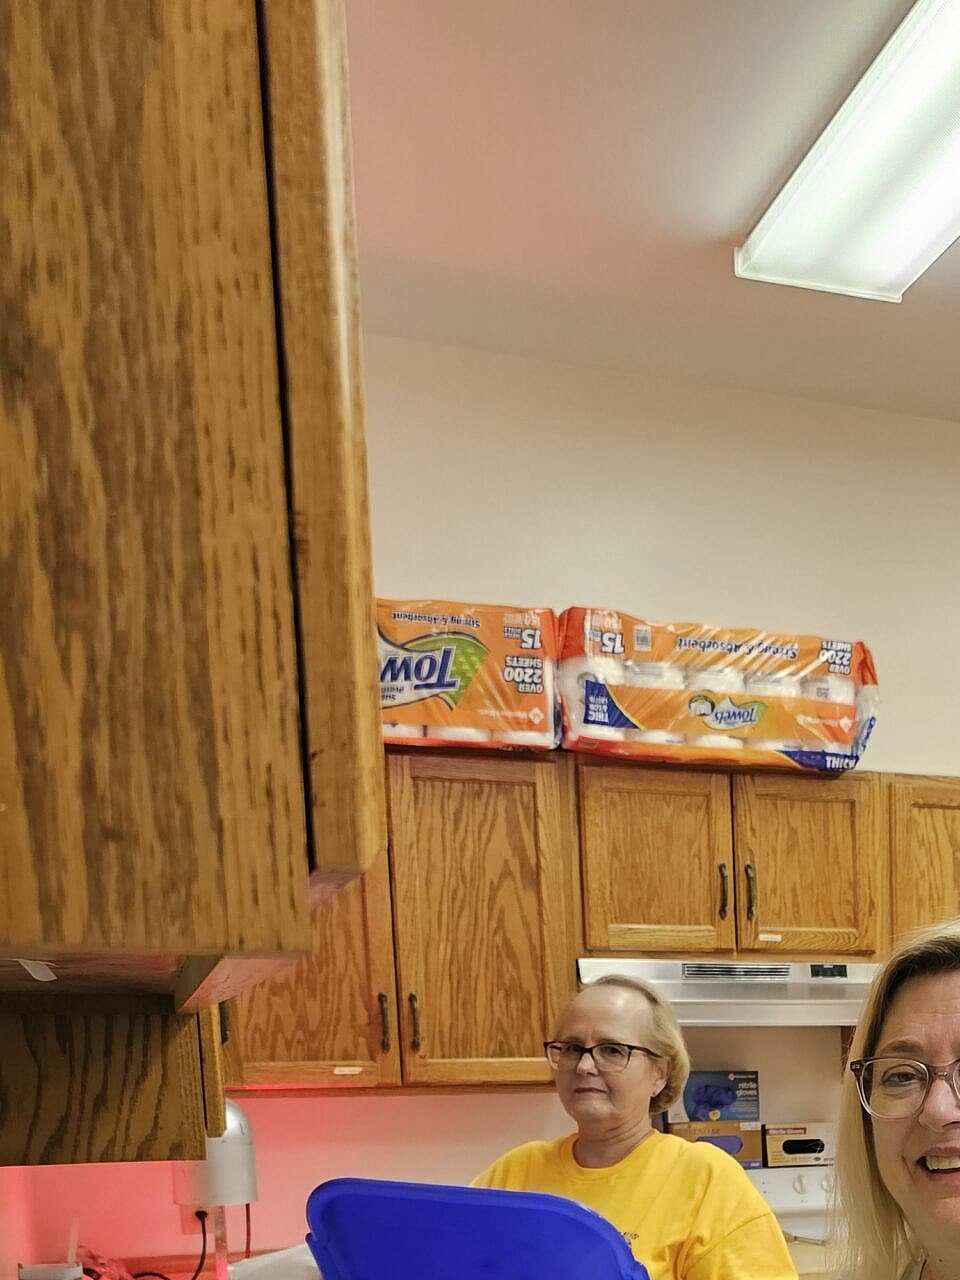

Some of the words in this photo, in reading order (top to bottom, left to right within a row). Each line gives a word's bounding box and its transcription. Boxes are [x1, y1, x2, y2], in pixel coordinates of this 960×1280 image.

[391, 610, 440, 625] Absorbent
[521, 628, 543, 650] 15
[600, 632, 625, 655] 15
[676, 637, 743, 654] Absorbent
[504, 656, 543, 667] SHEETS
[819, 649, 852, 665] 2200
[503, 667, 543, 683] 2200
[829, 663, 851, 675] OVER
[517, 683, 544, 694] OVER
[712, 708, 757, 726] Towels
